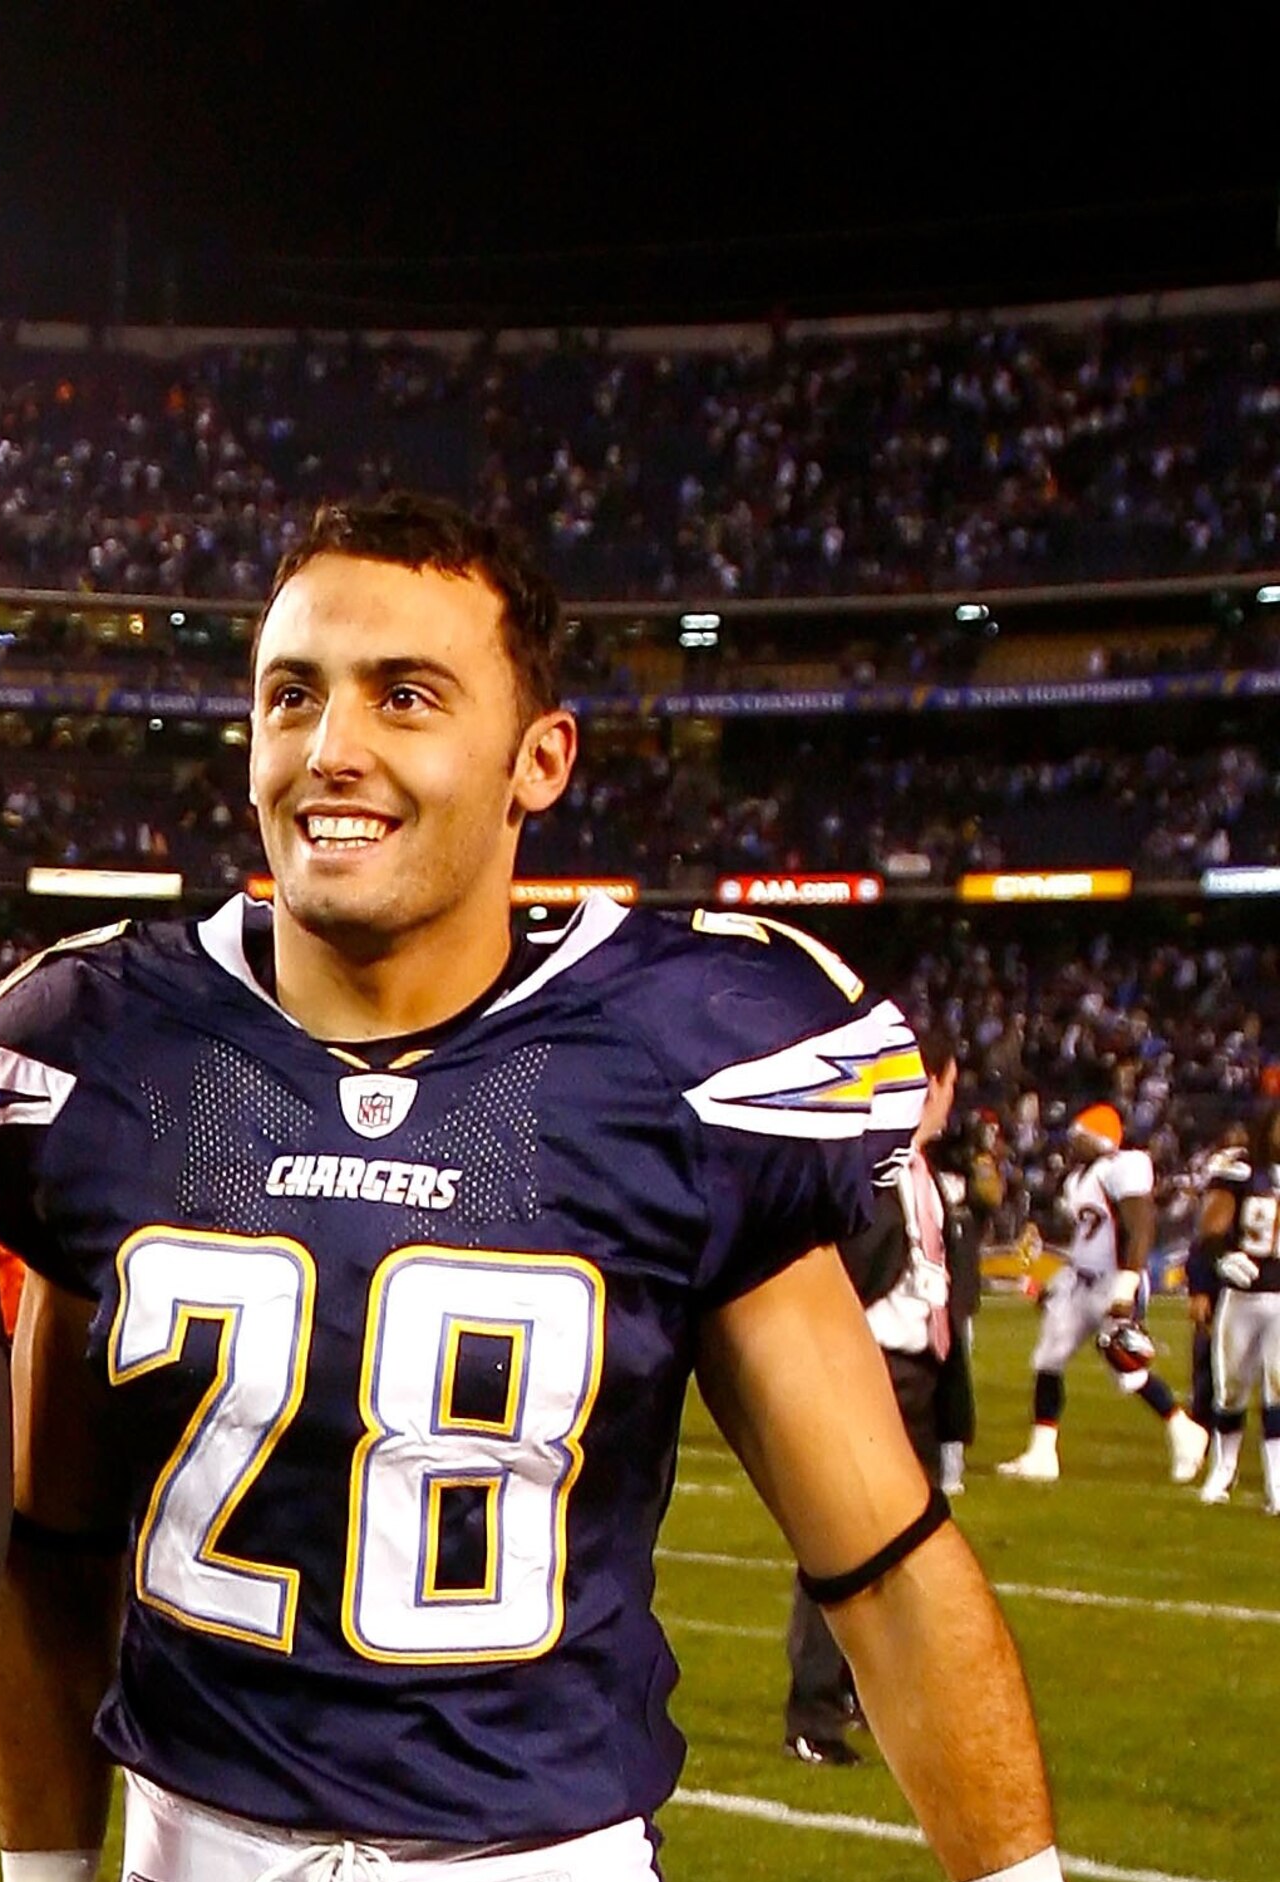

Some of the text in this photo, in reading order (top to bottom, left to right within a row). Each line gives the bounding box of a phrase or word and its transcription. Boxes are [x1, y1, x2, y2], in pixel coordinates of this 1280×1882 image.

[747, 879, 851, 904] AAA.com
[265, 1154, 464, 1211] CHARGERS
[108, 1225, 605, 1664] 28
